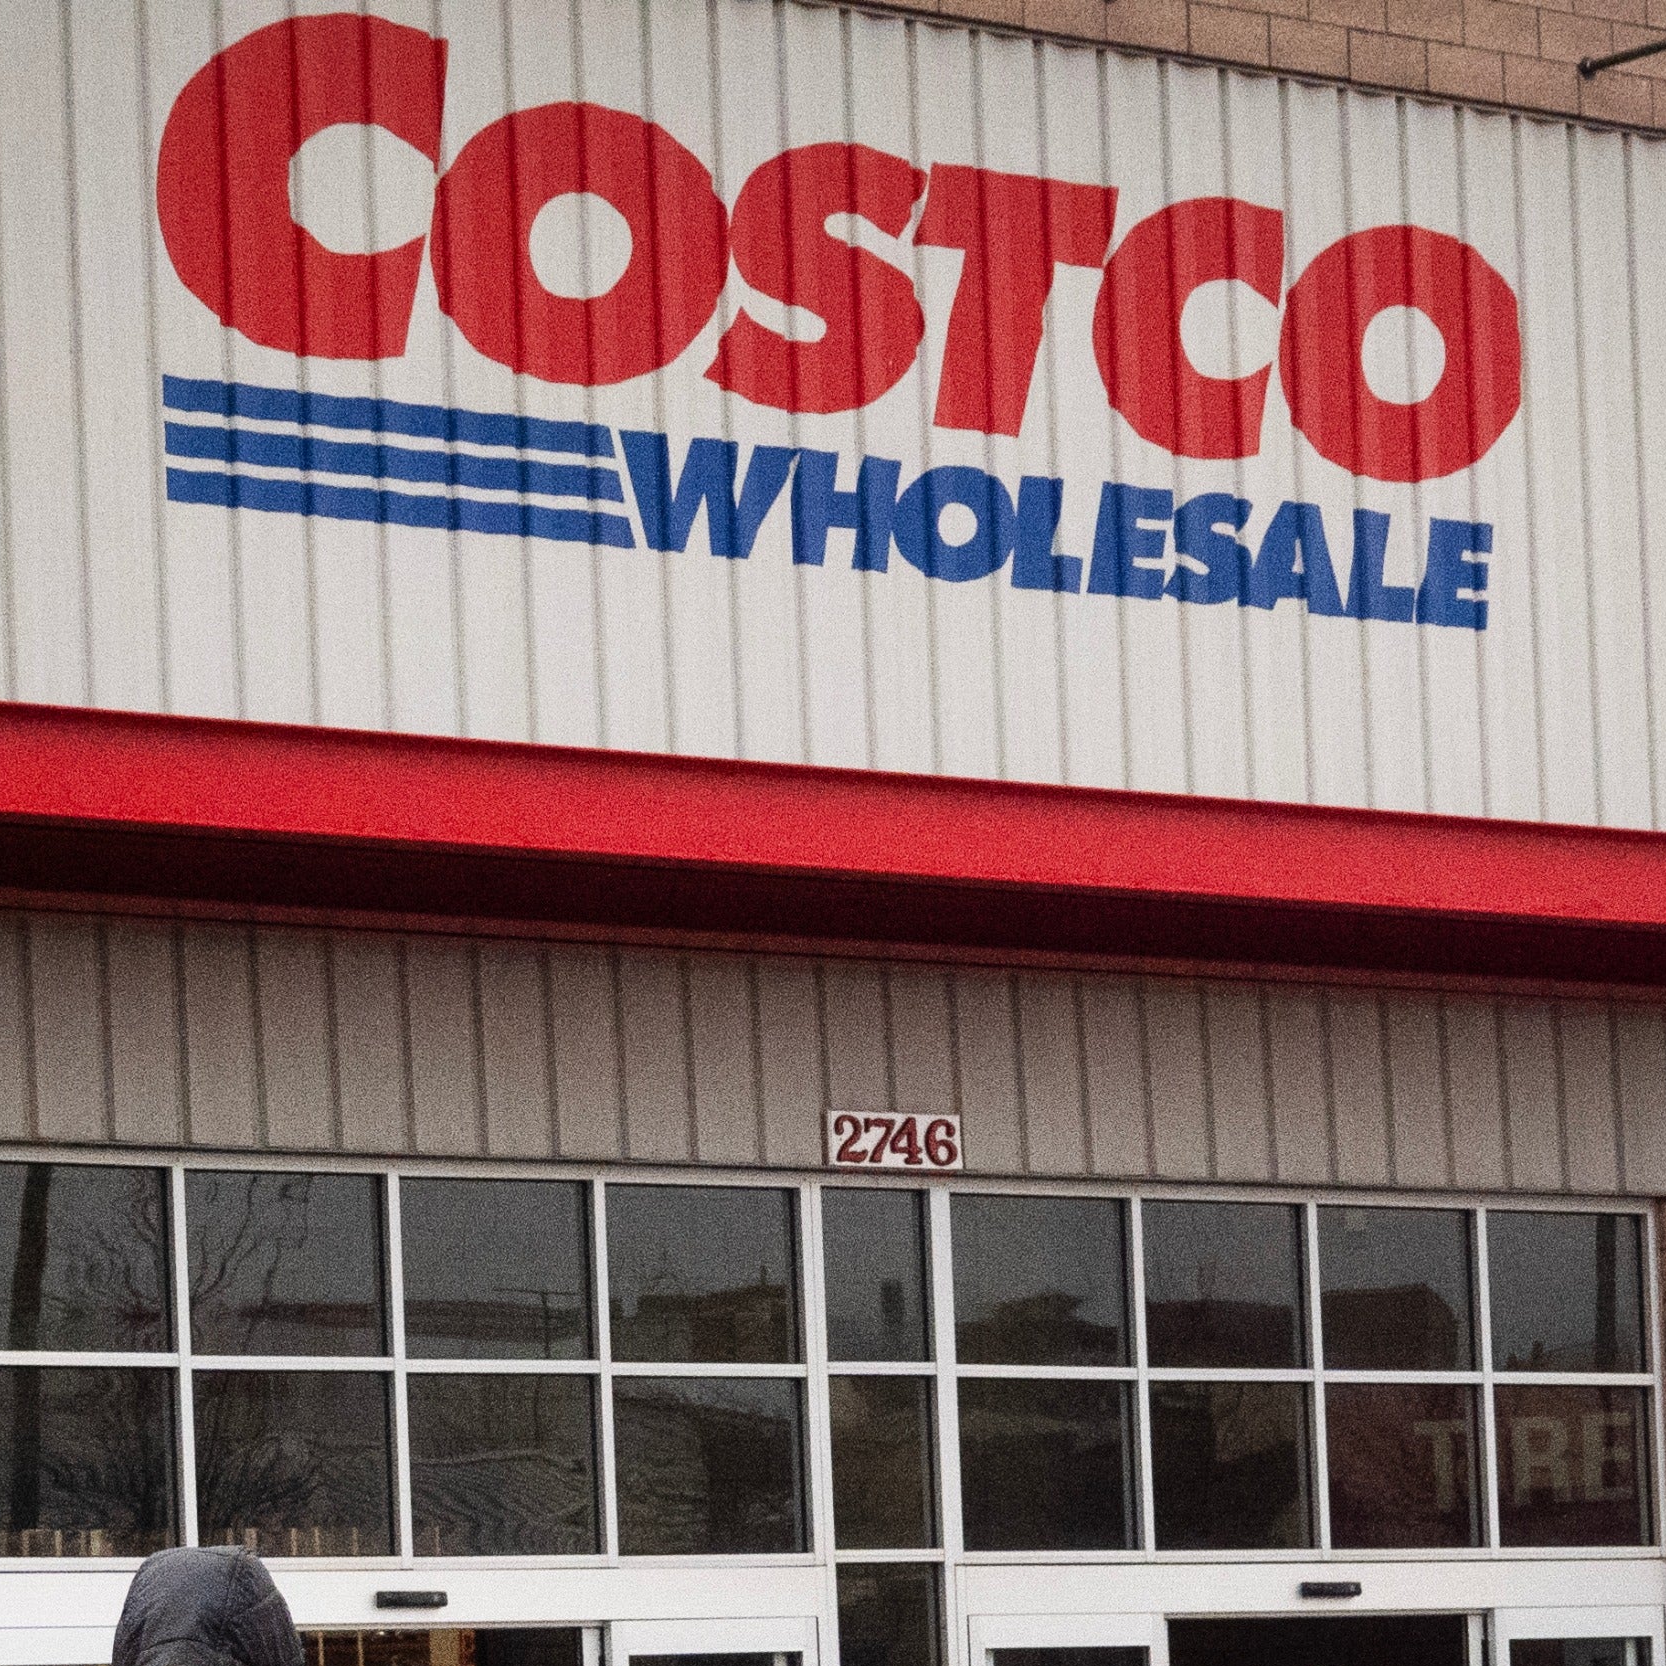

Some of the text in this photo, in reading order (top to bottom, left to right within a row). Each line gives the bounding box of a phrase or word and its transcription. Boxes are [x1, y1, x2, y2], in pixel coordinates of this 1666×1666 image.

[156, 13, 1522, 482] COSTCO
[619, 428, 1494, 631] WHOLESALE
[834, 1114, 957, 1166] 2746
[1413, 1411, 1633, 1512] TRE
